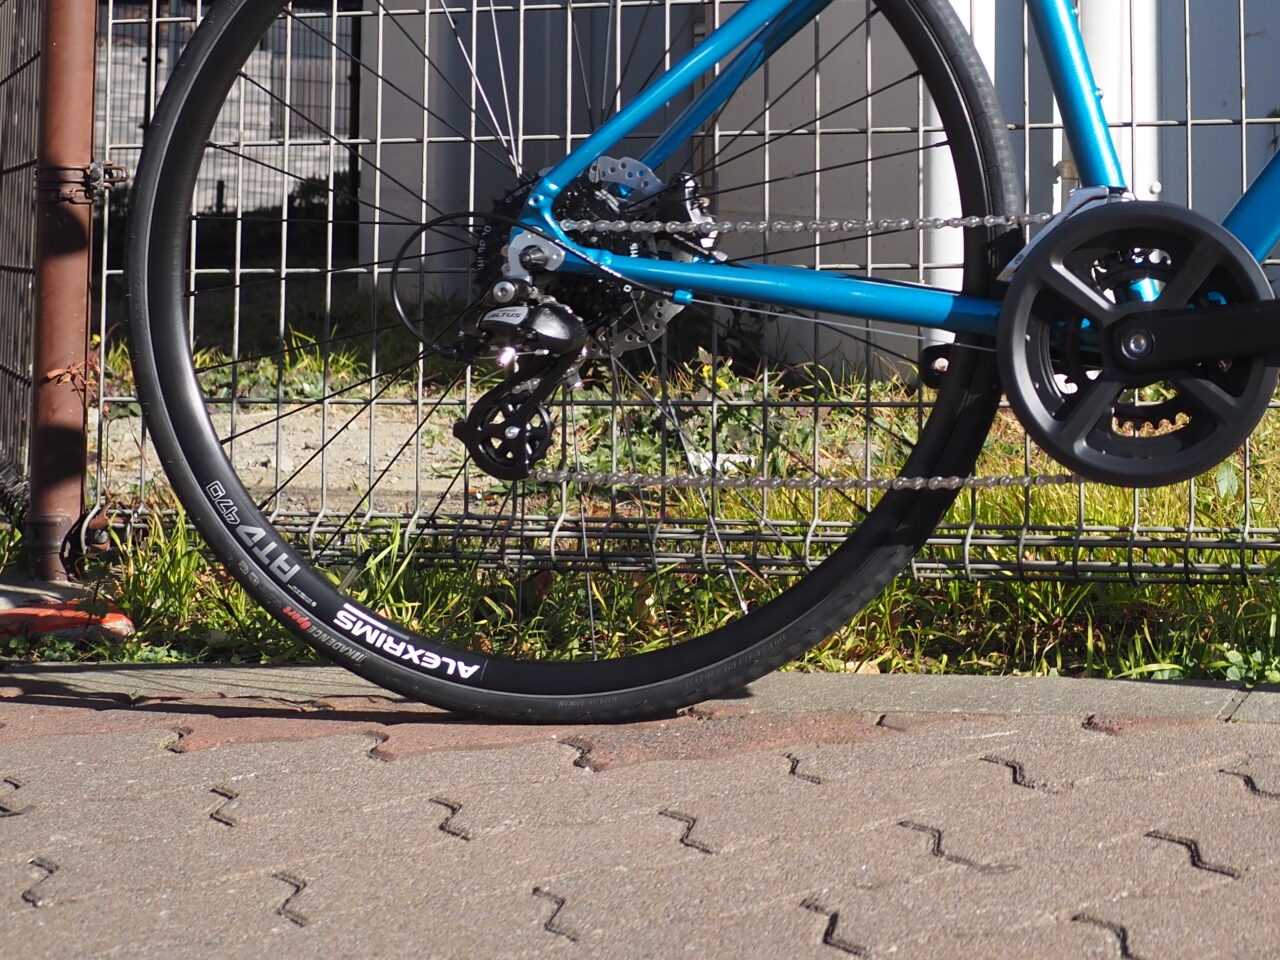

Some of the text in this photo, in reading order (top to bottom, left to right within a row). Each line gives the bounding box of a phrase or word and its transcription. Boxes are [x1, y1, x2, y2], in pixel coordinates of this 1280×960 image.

[206, 480, 242, 525] 470
[235, 525, 301, 584] ATD
[306, 625, 355, 658] KADENCE
[333, 609, 481, 680] ALEXRIMS
